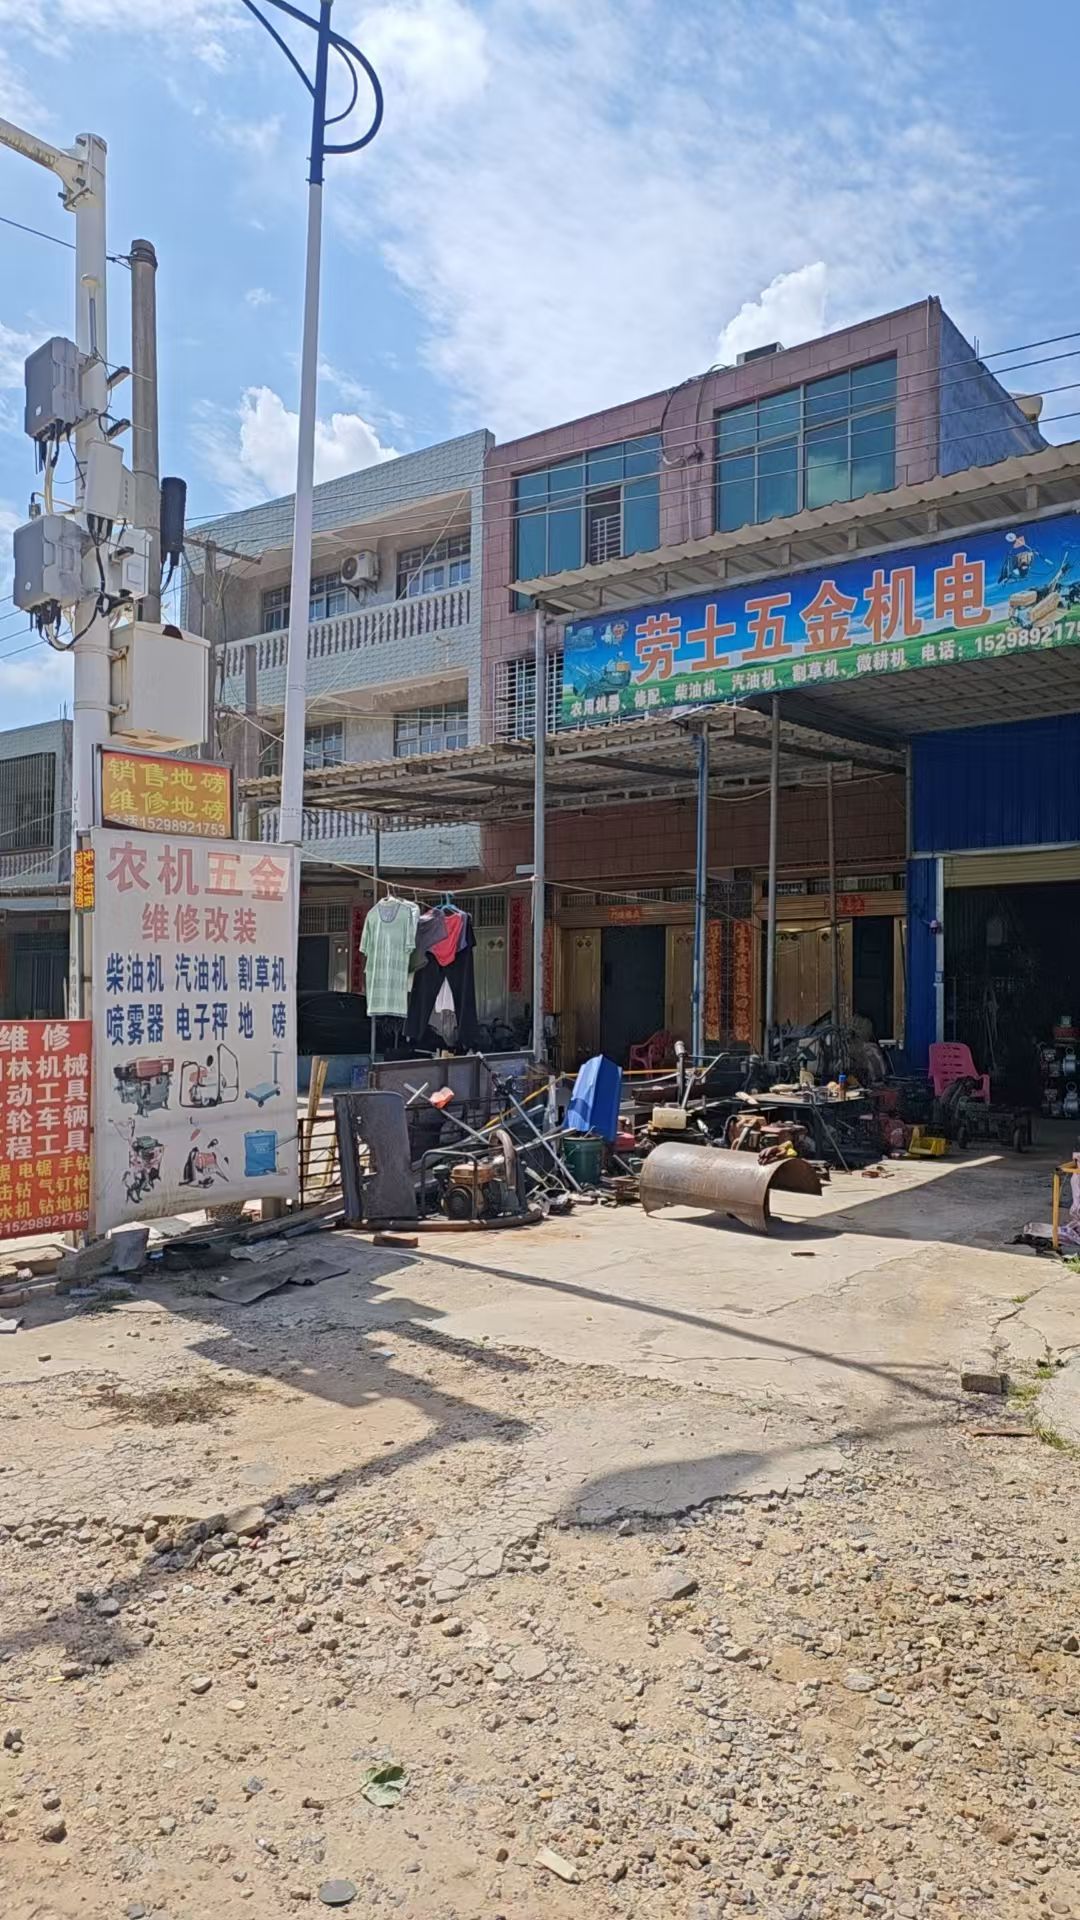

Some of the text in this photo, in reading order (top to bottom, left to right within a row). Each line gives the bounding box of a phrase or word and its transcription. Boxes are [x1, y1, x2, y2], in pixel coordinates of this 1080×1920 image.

[634, 552, 992, 686] 劳士五金机电
[108, 757, 225, 794] 销售地磅
[109, 787, 225, 822] 维修地磅
[106, 841, 286, 902] 农机五金
[142, 902, 257, 944] 维修改装
[106, 953, 164, 995] 柴油机
[175, 953, 228, 992] 汽油机
[238, 954, 286, 992] 割草机
[0, 1023, 70, 1053] 维修
[106, 1001, 286, 1046] 喷雾器 电子秤 地磅
[0, 1053, 89, 1081] 林机械
[0, 1079, 88, 1107] 动工具
[0, 1104, 88, 1134] 轮车辆
[0, 1130, 88, 1160] 程工具
[0, 1211, 89, 1234] 15298921753
